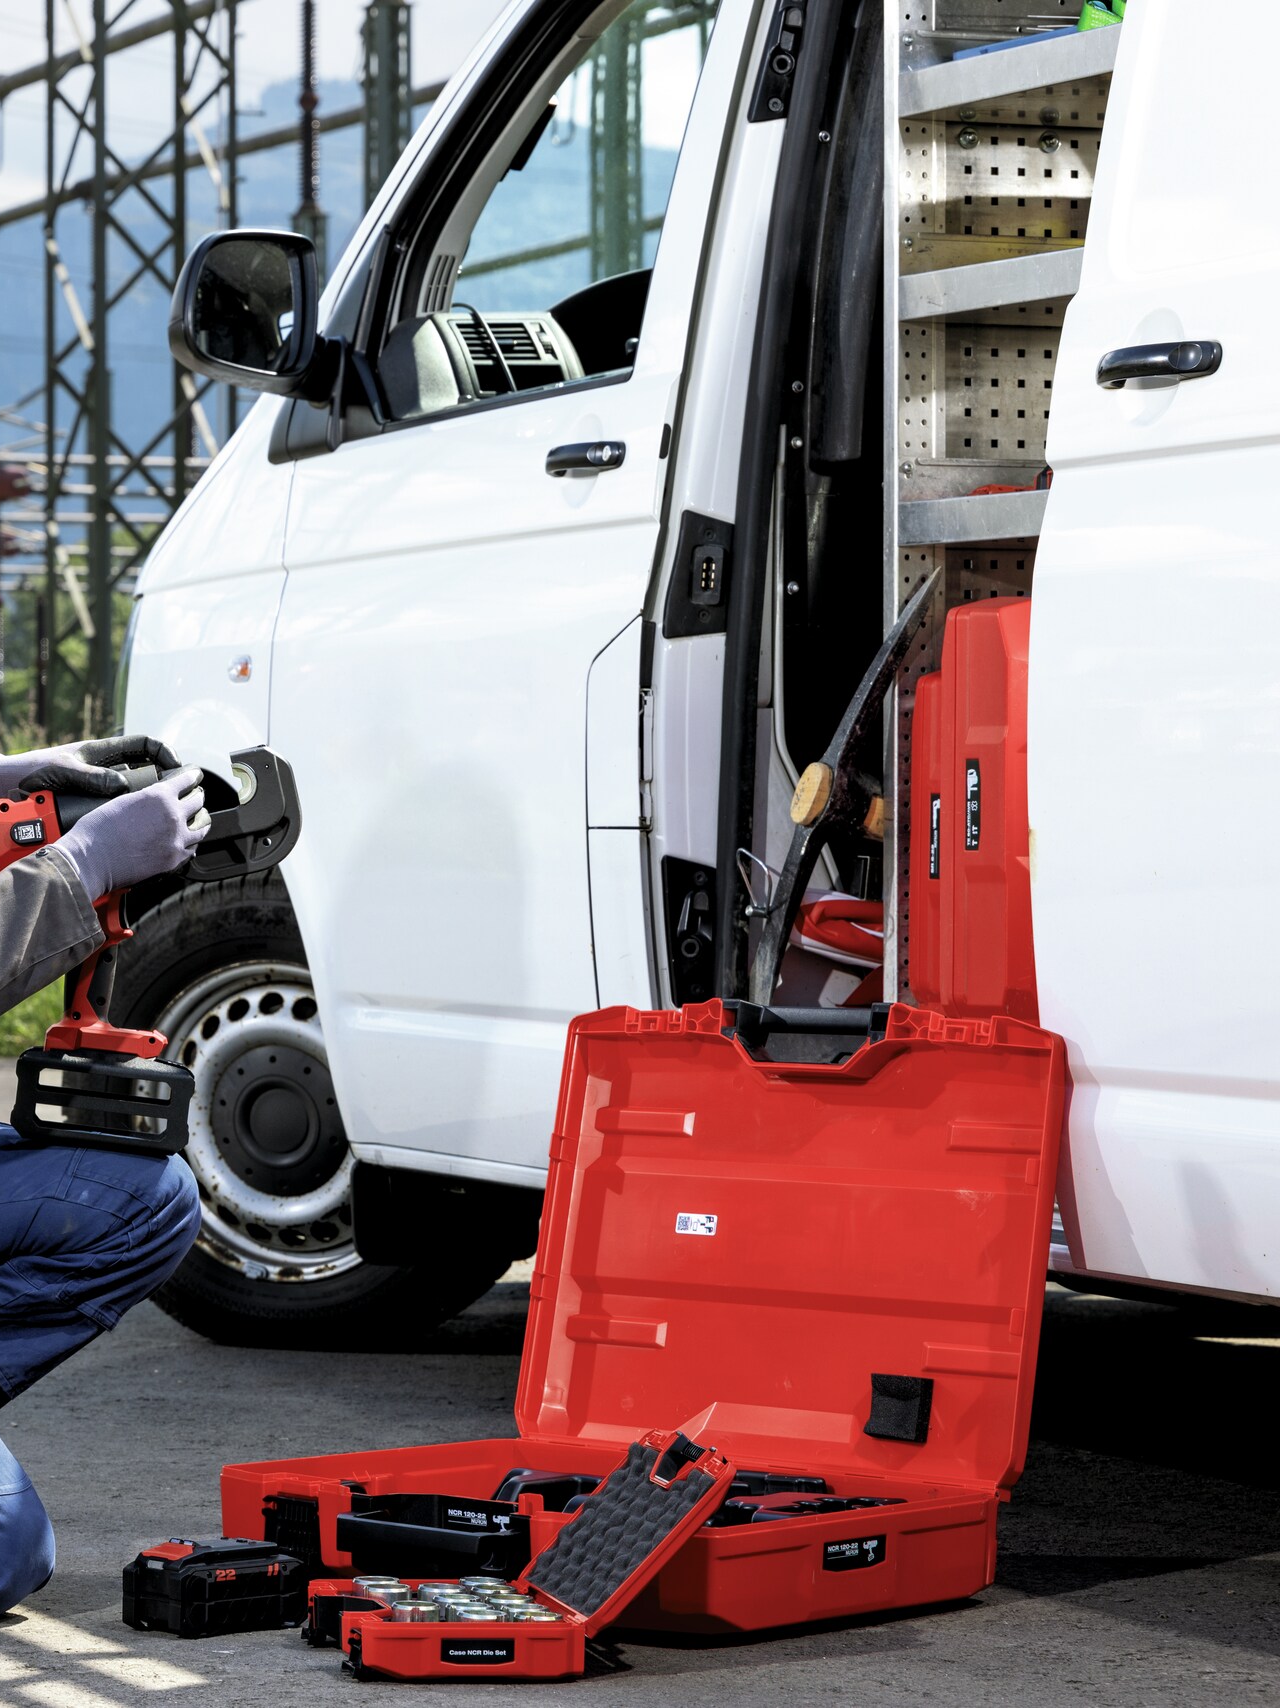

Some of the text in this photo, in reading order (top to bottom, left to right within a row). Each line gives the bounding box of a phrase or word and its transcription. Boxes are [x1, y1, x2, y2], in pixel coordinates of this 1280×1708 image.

[447, 1508, 487, 1520] NCR 120-22
[827, 1542, 859, 1553] NCR 120-22
[215, 1568, 236, 1582] 22
